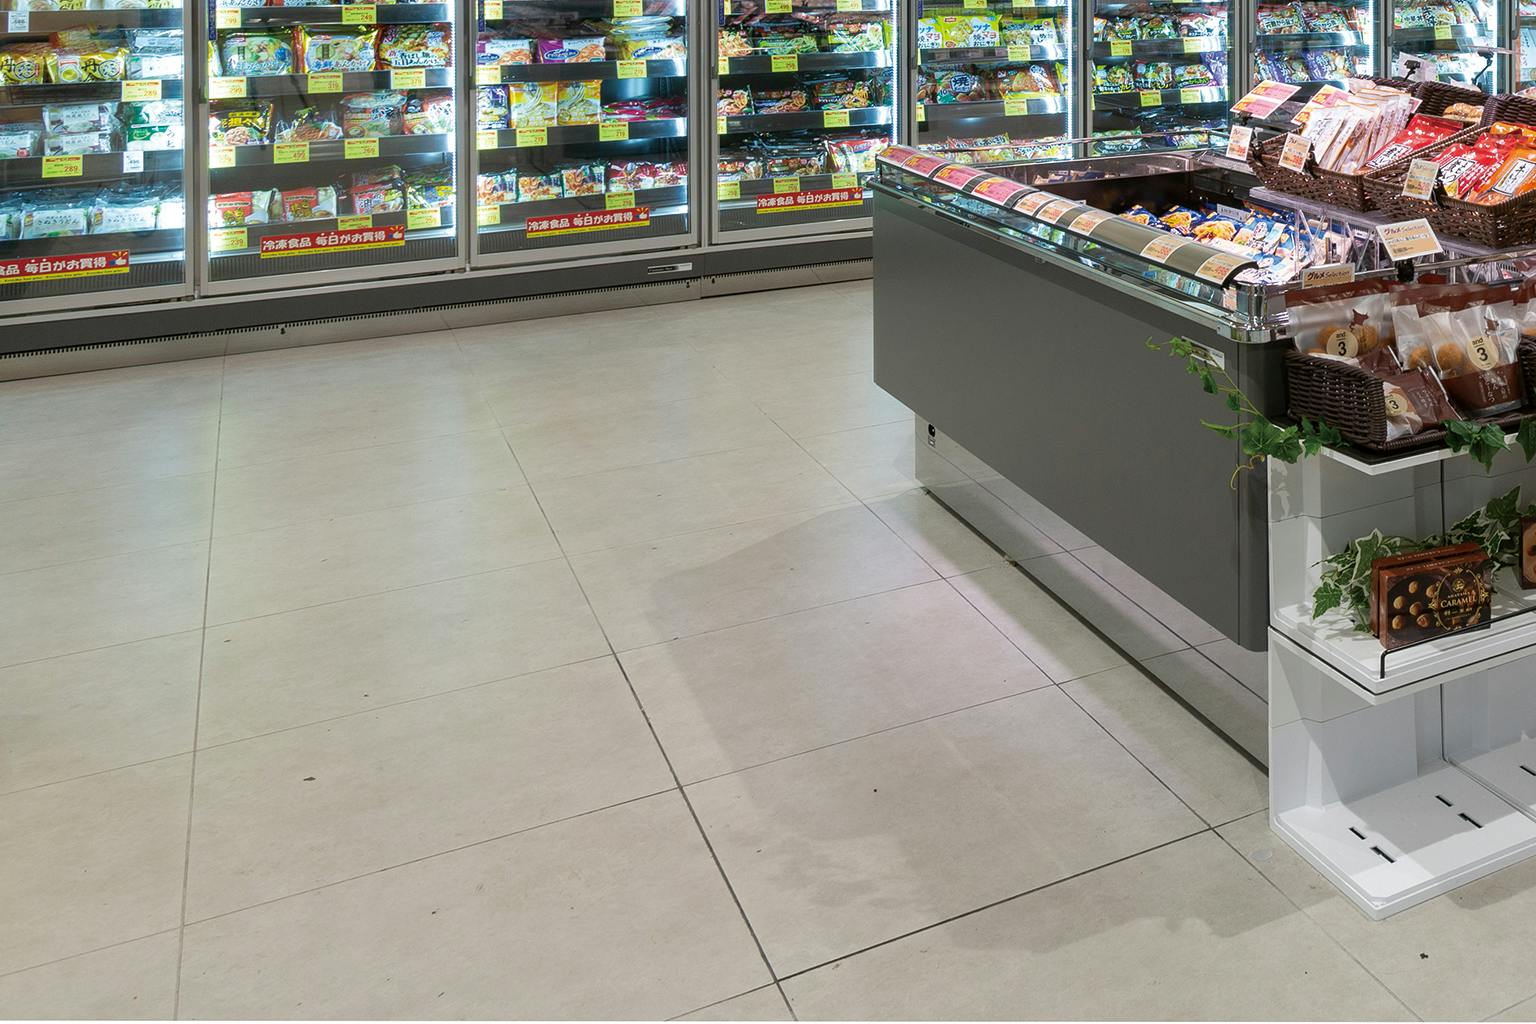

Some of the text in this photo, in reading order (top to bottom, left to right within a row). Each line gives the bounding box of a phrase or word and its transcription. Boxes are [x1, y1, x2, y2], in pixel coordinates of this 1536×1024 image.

[758, 195, 794, 207] 冷凍食品
[796, 191, 849, 204] 毎日がお買得
[528, 217, 570, 231] 冷凍食品
[573, 211, 633, 227] 毎日がお買得
[262, 238, 311, 251] 冷凍食品
[315, 231, 386, 247] 毎日がお買得
[25, 257, 107, 274] 毎日がお買得
[1335, 331, 1346, 339] and
[1471, 336, 1484, 346] and
[1337, 341, 1347, 356] 3
[1478, 346, 1489, 362] 3
[1389, 400, 1399, 409] 3
[1441, 597, 1476, 607] CARAMEL
